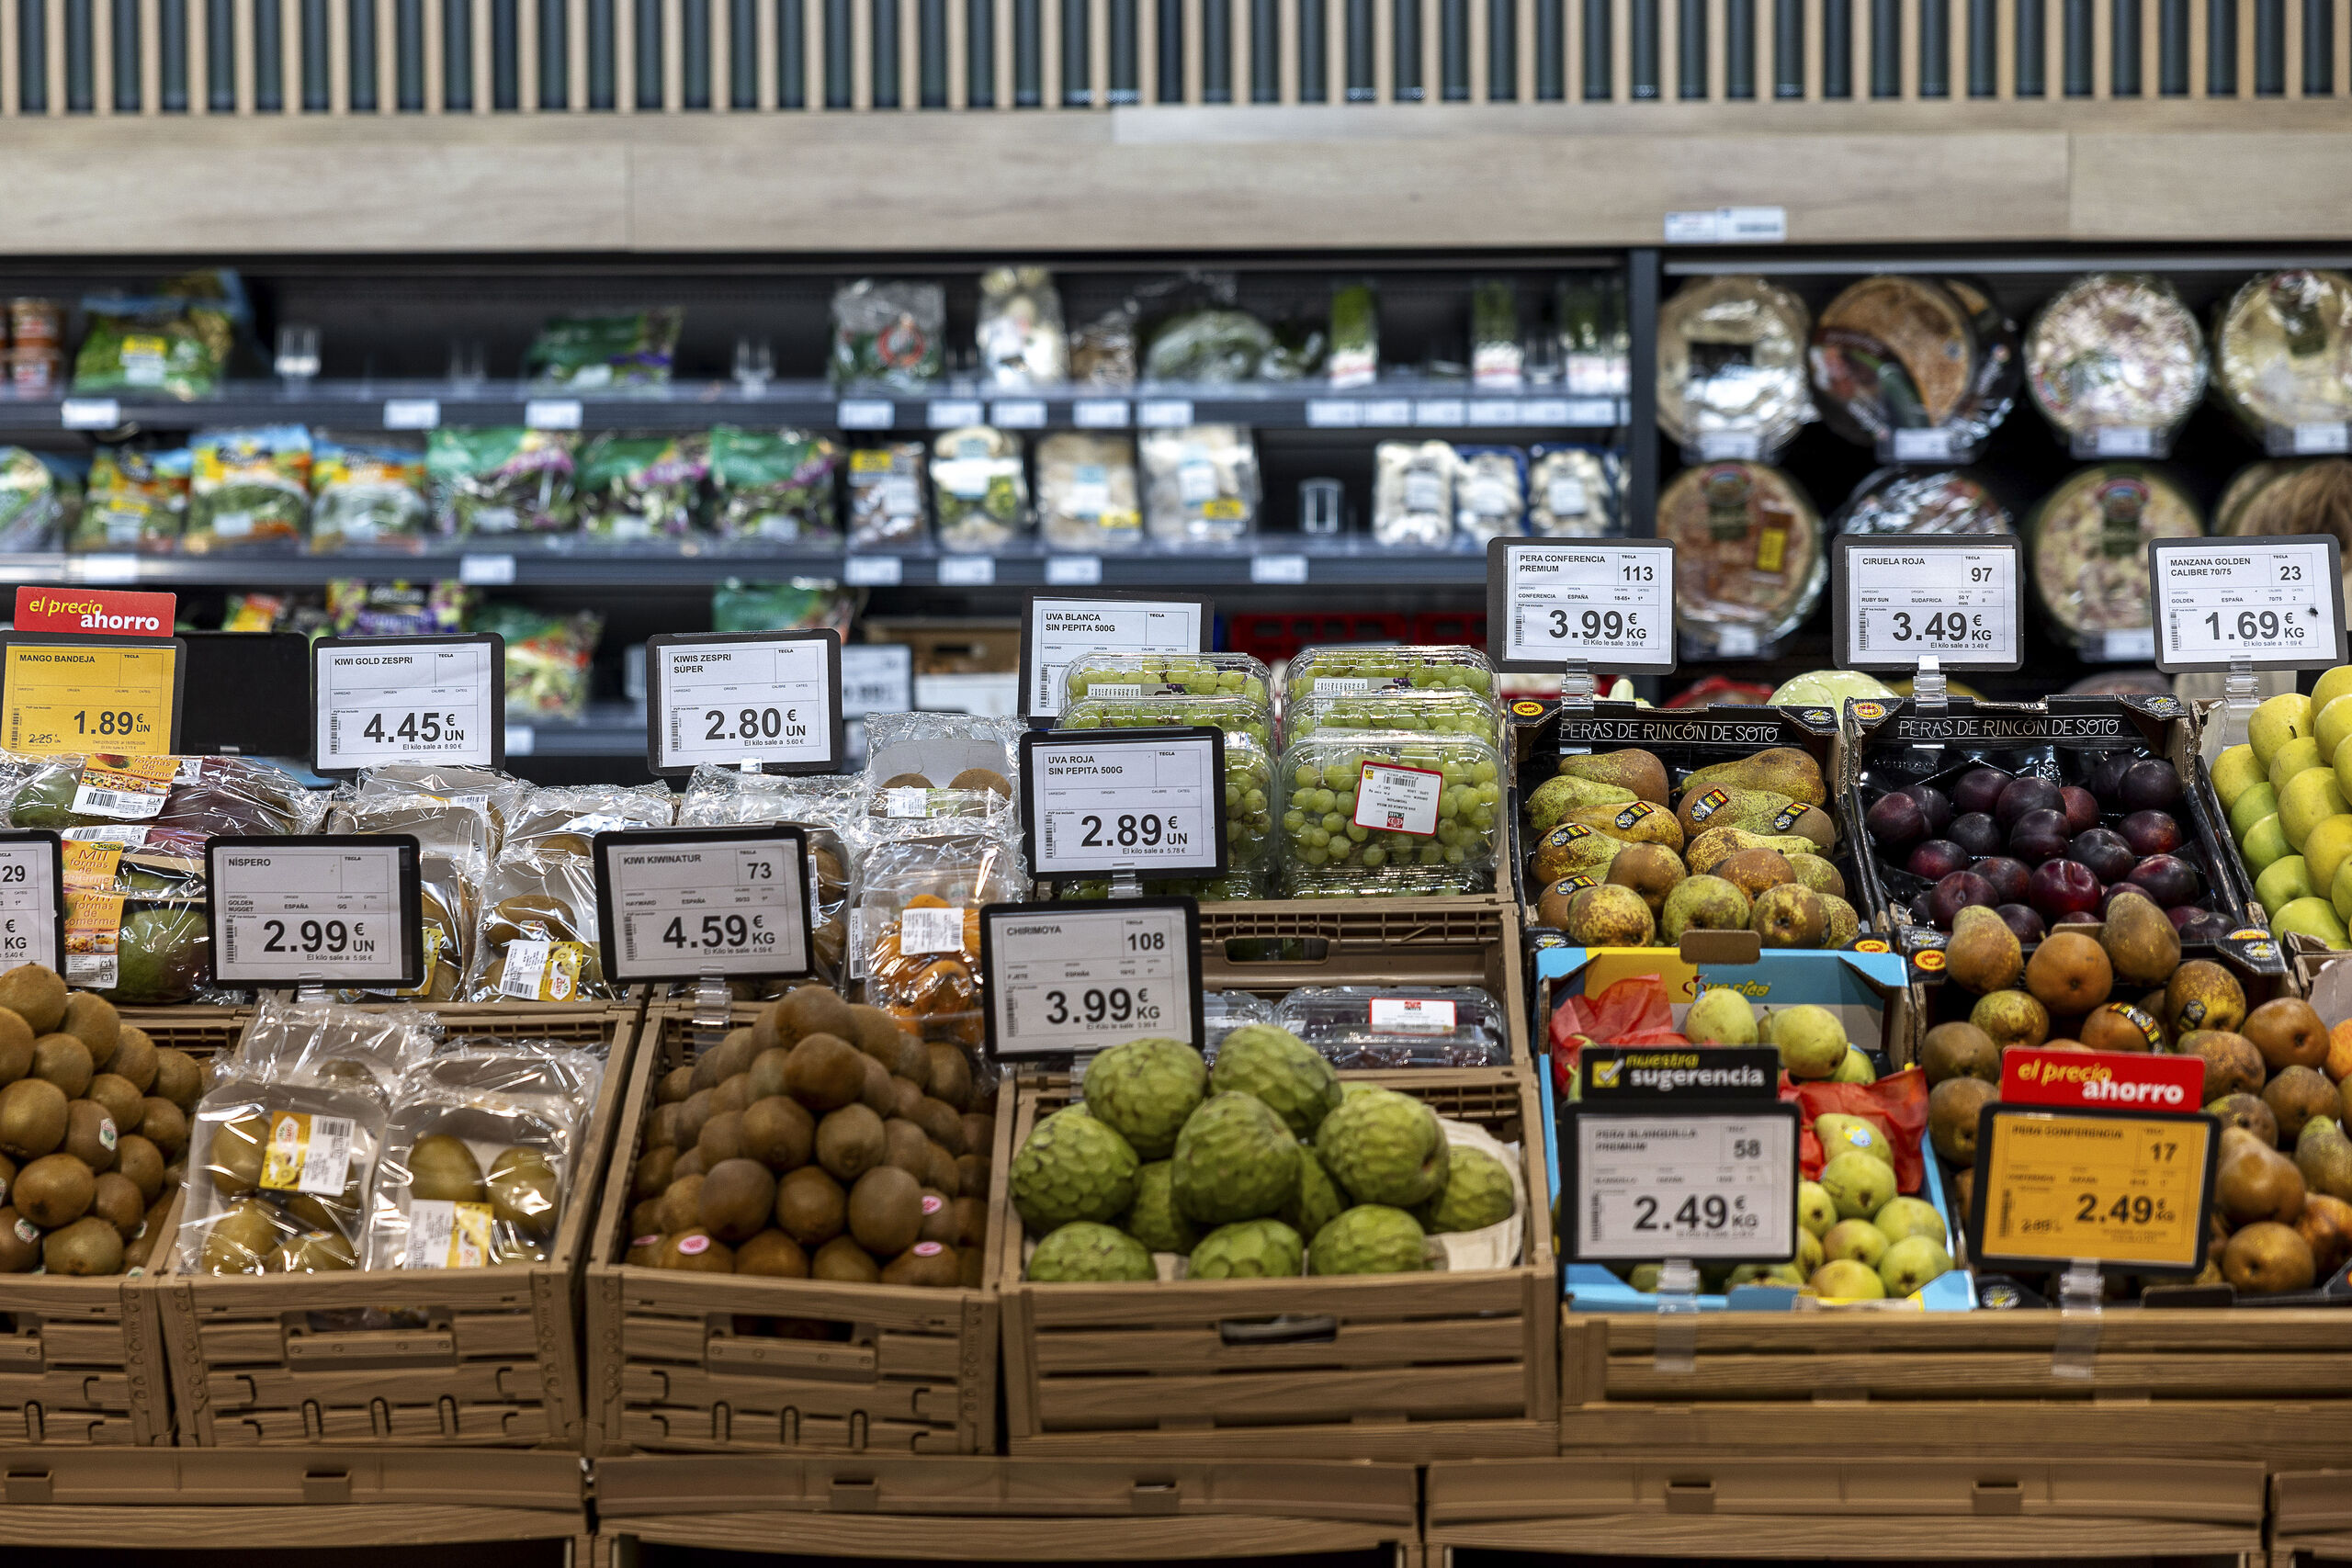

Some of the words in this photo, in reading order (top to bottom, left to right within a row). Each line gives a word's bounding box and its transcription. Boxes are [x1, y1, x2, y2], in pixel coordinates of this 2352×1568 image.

[1545, 555, 1605, 563] CONFERENCIA
[2170, 558, 2212, 567] MANZANA
[2215, 558, 2251, 566] GOLDEN
[1623, 566, 1654, 581] 113
[1971, 567, 1993, 582] 97
[2279, 566, 2302, 581] 23
[29, 596, 46, 612] el
[48, 600, 103, 616] precio
[80, 611, 160, 631] ahorro
[1046, 624, 1060, 632] SIN
[1062, 624, 1092, 632] PEPITA
[1549, 610, 1623, 639] 3.99
[1628, 613, 1637, 625] €
[1893, 612, 1967, 641] 3.49
[1973, 615, 1982, 626] €
[2205, 611, 2279, 640] 1.69
[2285, 612, 2293, 624] €
[1627, 628, 1646, 638] KG
[1972, 630, 1991, 640] KG
[2284, 627, 2304, 638] KG
[19, 654, 52, 662] MANGO
[54, 655, 96, 663] BANDEJA
[334, 658, 354, 666] KIWI
[673, 655, 698, 663] KIWIS
[700, 653, 731, 661] ZESPRI
[74, 710, 134, 735] 1.89
[136, 714, 143, 723] €
[136, 724, 151, 732] UN
[364, 713, 441, 743] 4.45
[446, 714, 455, 726] €
[705, 707, 782, 740] 2.80
[786, 709, 797, 722] €
[1898, 720, 1952, 739] PERAS
[1958, 720, 1979, 736] DE
[1983, 717, 2047, 738] RINCÓN
[2052, 719, 2074, 735] DE
[2076, 719, 2120, 735] SOTO
[445, 730, 464, 740] UN
[786, 726, 806, 736] UN
[1560, 722, 1612, 739] PERAS
[1617, 723, 1639, 739] DE
[1643, 722, 1707, 741] RINCÓN
[1712, 725, 1733, 741] DE
[1736, 726, 1779, 742] SOTO
[1048, 756, 1067, 764] UVA
[1069, 755, 1095, 764] ROJA
[1048, 767, 1064, 775] SIN
[1066, 766, 1099, 775] PEPITA
[1101, 766, 1123, 774] 500G
[1080, 814, 1161, 847] 2.89
[1168, 816, 1178, 829] €
[1167, 832, 1187, 845] UN
[70, 858, 108, 868] formas
[79, 850, 109, 861] Mil
[623, 856, 645, 865] KIWI
[647, 854, 701, 864] KIWINATUR
[2, 865, 26, 882] 29
[747, 863, 772, 879] 73
[74, 900, 113, 910] formas
[84, 908, 96, 917] de
[6, 919, 16, 932] €
[663, 914, 748, 949] 4.59
[753, 915, 763, 929] €
[1007, 926, 1061, 936] CHIRIMOYA
[5, 937, 27, 949] KG
[264, 919, 347, 953] 2.99
[354, 922, 364, 936] €
[752, 932, 775, 944] KG
[1127, 932, 1164, 951] 108
[353, 941, 374, 952] UN
[1046, 987, 1132, 1025] 3.99
[1137, 988, 1148, 1002] €
[1136, 1007, 1159, 1020] KG
[1631, 1066, 1765, 1091] sugerencia
[2018, 1059, 2040, 1081] el
[2041, 1063, 2112, 1087] precio
[2082, 1077, 2184, 1104] ahorro
[1734, 1139, 1761, 1159] 58
[2150, 1143, 2177, 1161] 17
[1634, 1195, 1726, 1231] 2.49
[2076, 1194, 2154, 1224] 2.49
